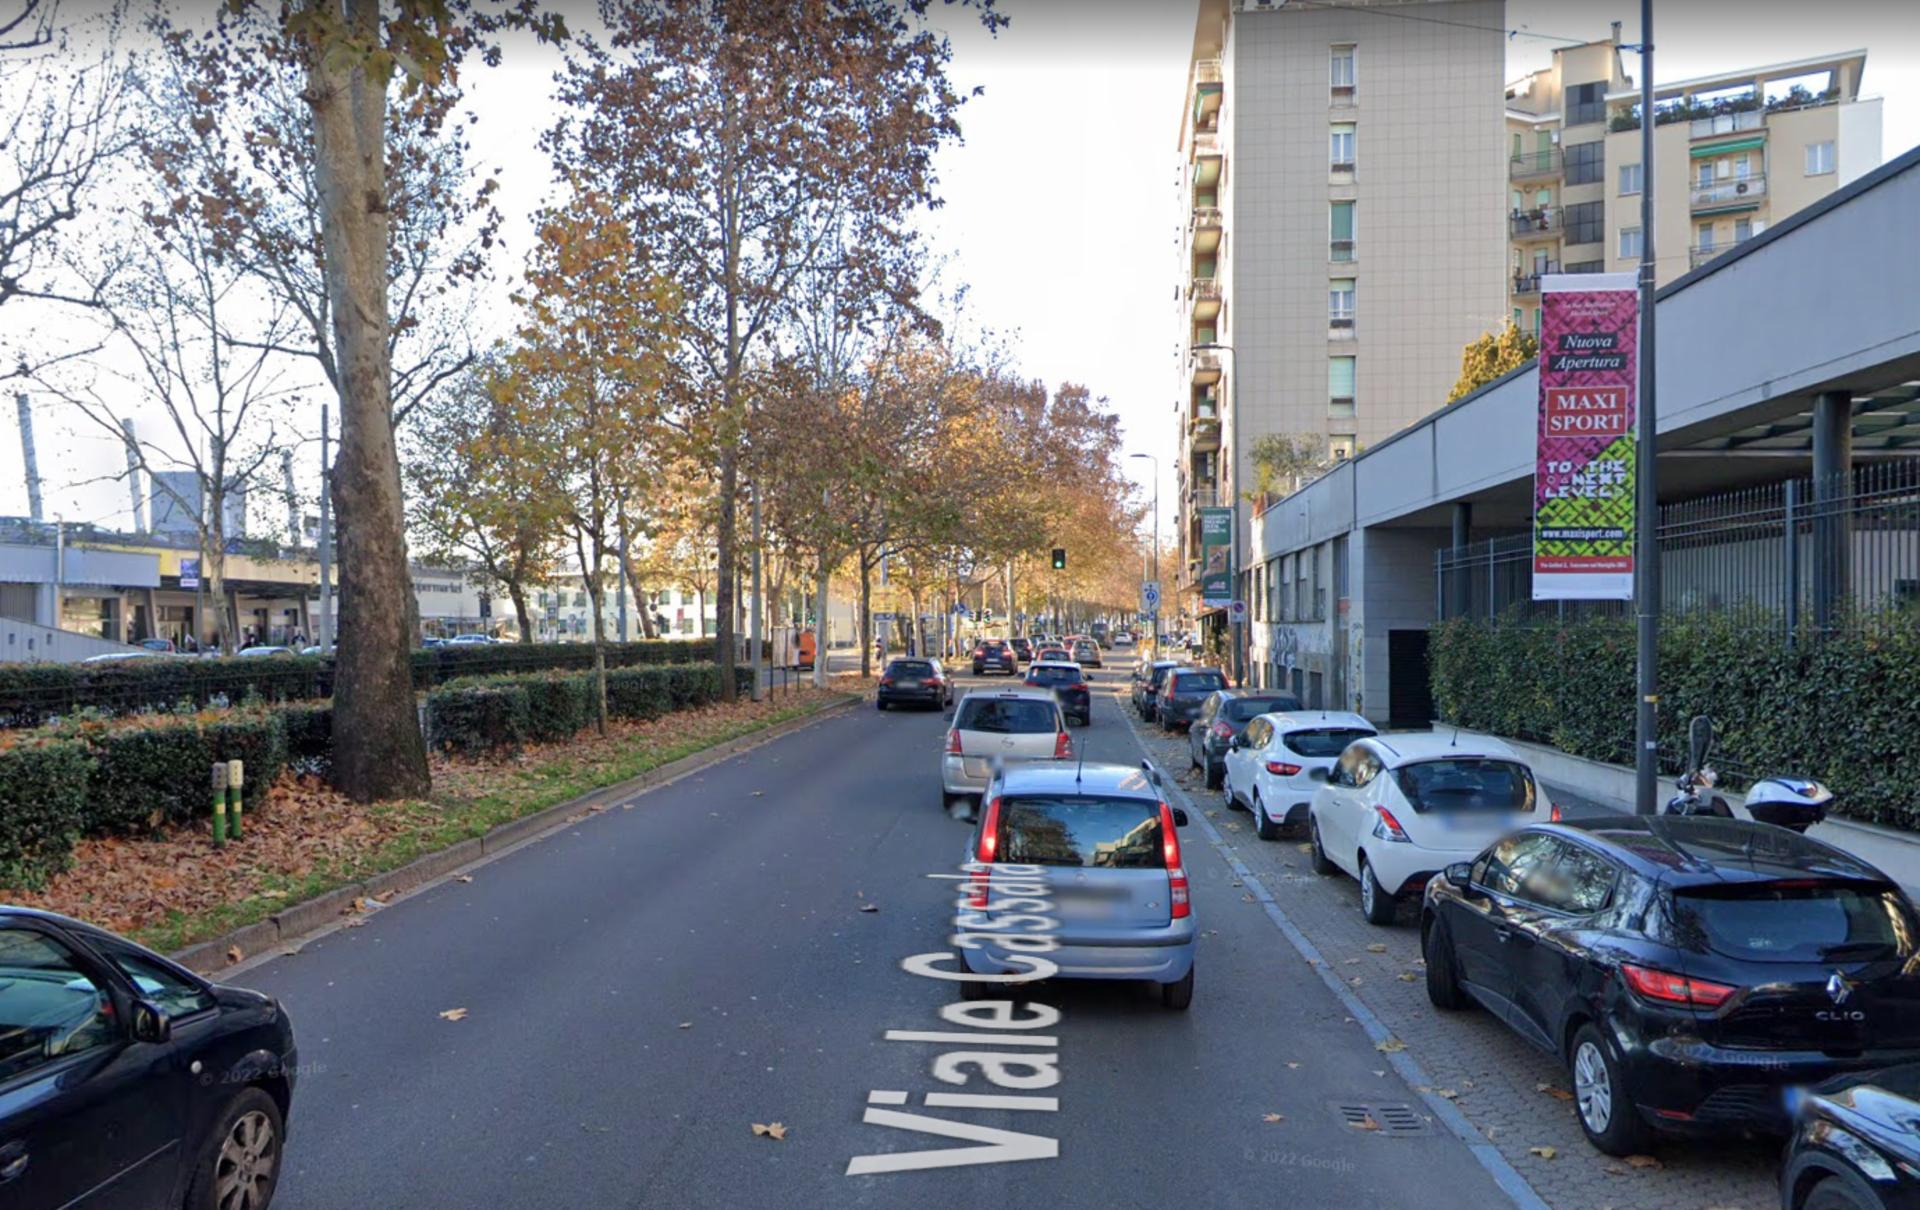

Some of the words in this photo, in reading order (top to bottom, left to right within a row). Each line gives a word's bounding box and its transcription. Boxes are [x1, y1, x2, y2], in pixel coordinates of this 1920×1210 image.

[1565, 335, 1612, 349] Nuova
[1555, 356, 1619, 372] Apertura
[1557, 394, 1617, 410] MAXI
[1550, 414, 1623, 431] SPORT
[1547, 461, 1572, 473] TO
[1588, 460, 1625, 473] THE
[1572, 473, 1626, 485] NEXT
[1544, 485, 1613, 498] LEVEL
[1542, 529, 1622, 540] www.maxisport.com
[1815, 1010, 1866, 1022] CLIO
